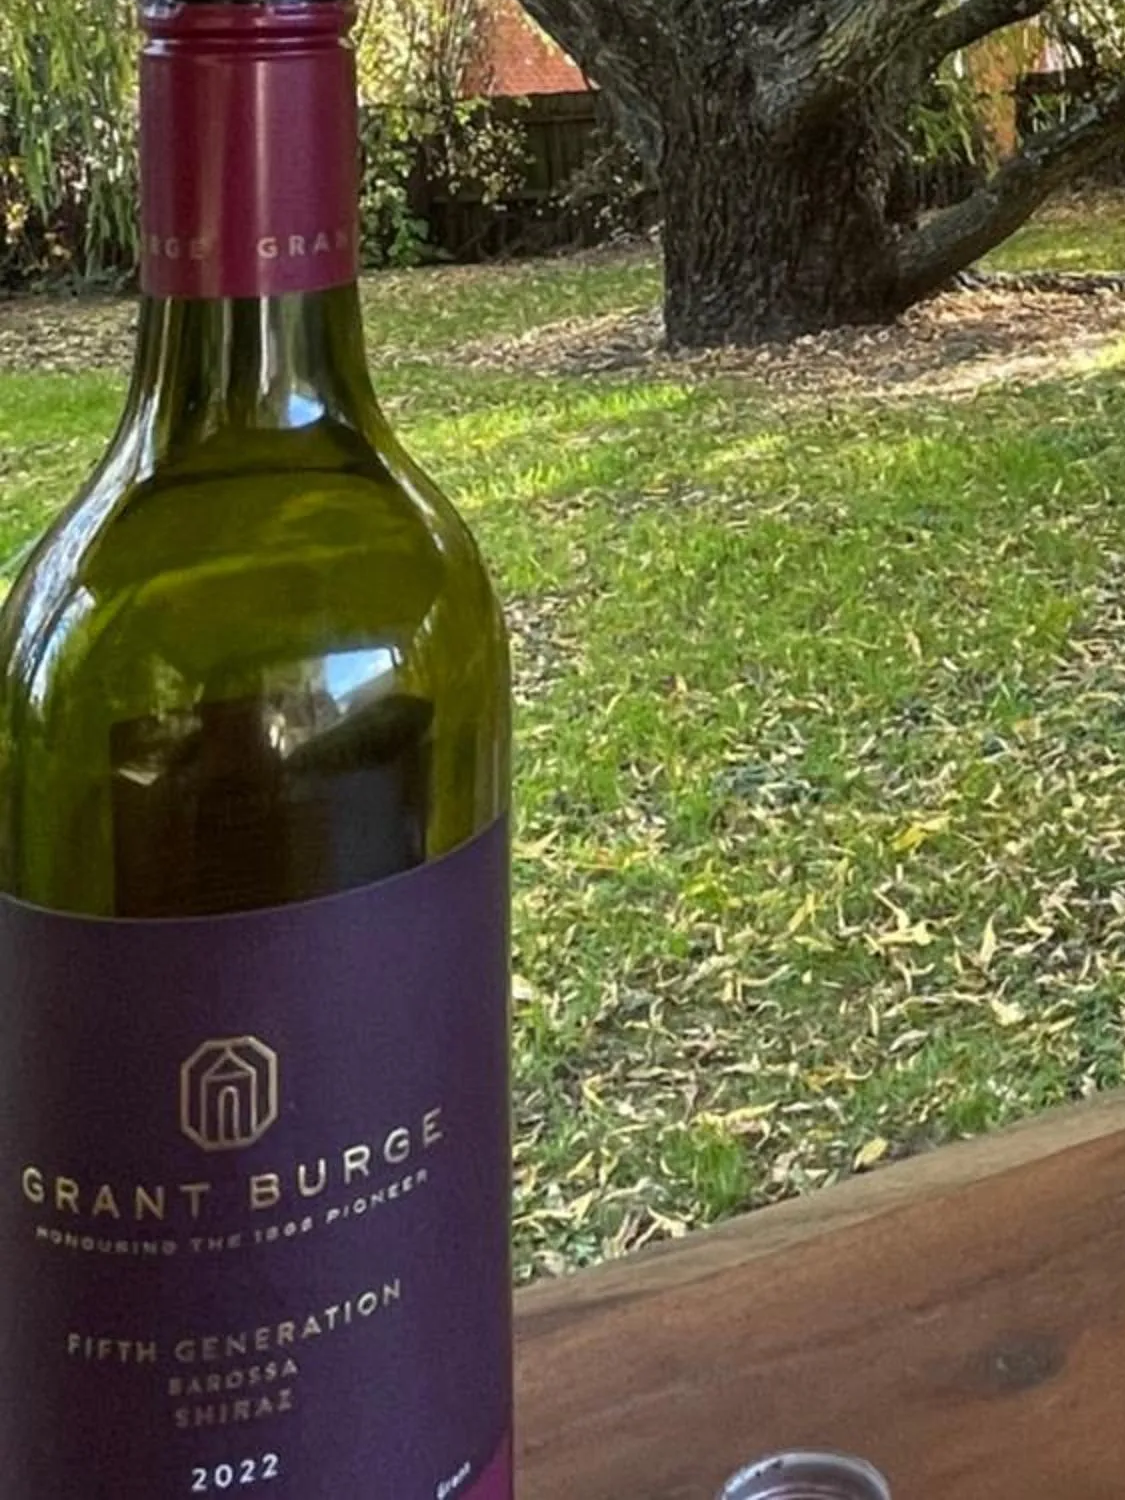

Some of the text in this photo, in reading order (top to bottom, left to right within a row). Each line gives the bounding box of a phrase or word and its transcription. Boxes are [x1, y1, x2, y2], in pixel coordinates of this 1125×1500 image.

[22, 1107, 443, 1221] GRANT BURGE
[191, 1233, 242, 1253] THE
[325, 1168, 429, 1224] PIONEER
[67, 1277, 401, 1364] FIFTH GENERATION
[168, 1358, 299, 1397] BAROSSA
[174, 1387, 294, 1428] SHIRAZ
[191, 1453, 280, 1491] 2022
